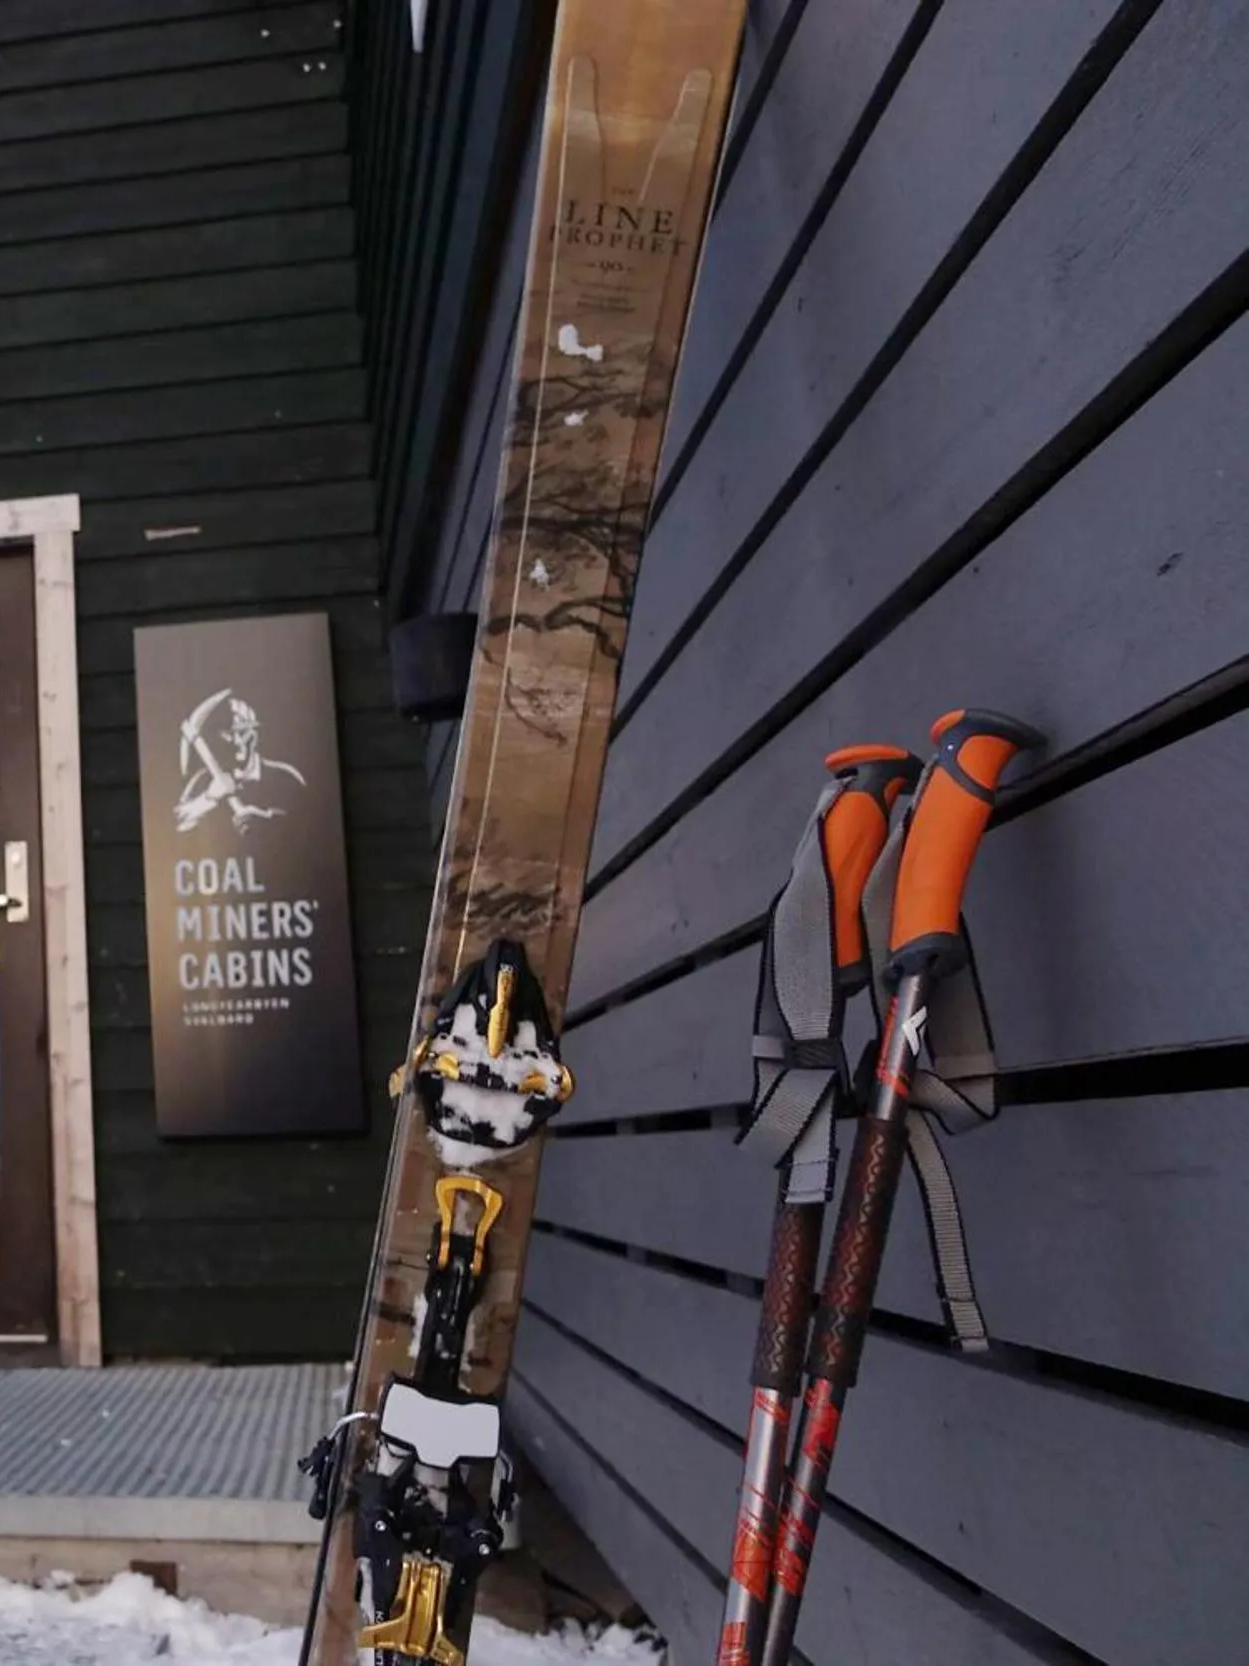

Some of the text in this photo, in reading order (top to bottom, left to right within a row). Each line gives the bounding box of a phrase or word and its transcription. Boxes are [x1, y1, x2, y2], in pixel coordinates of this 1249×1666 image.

[565, 199, 674, 235] LINE
[549, 224, 689, 257] PROPHET
[175, 857, 266, 896] COAL
[177, 899, 319, 943] MINERS'
[179, 946, 313, 990] CABINS
